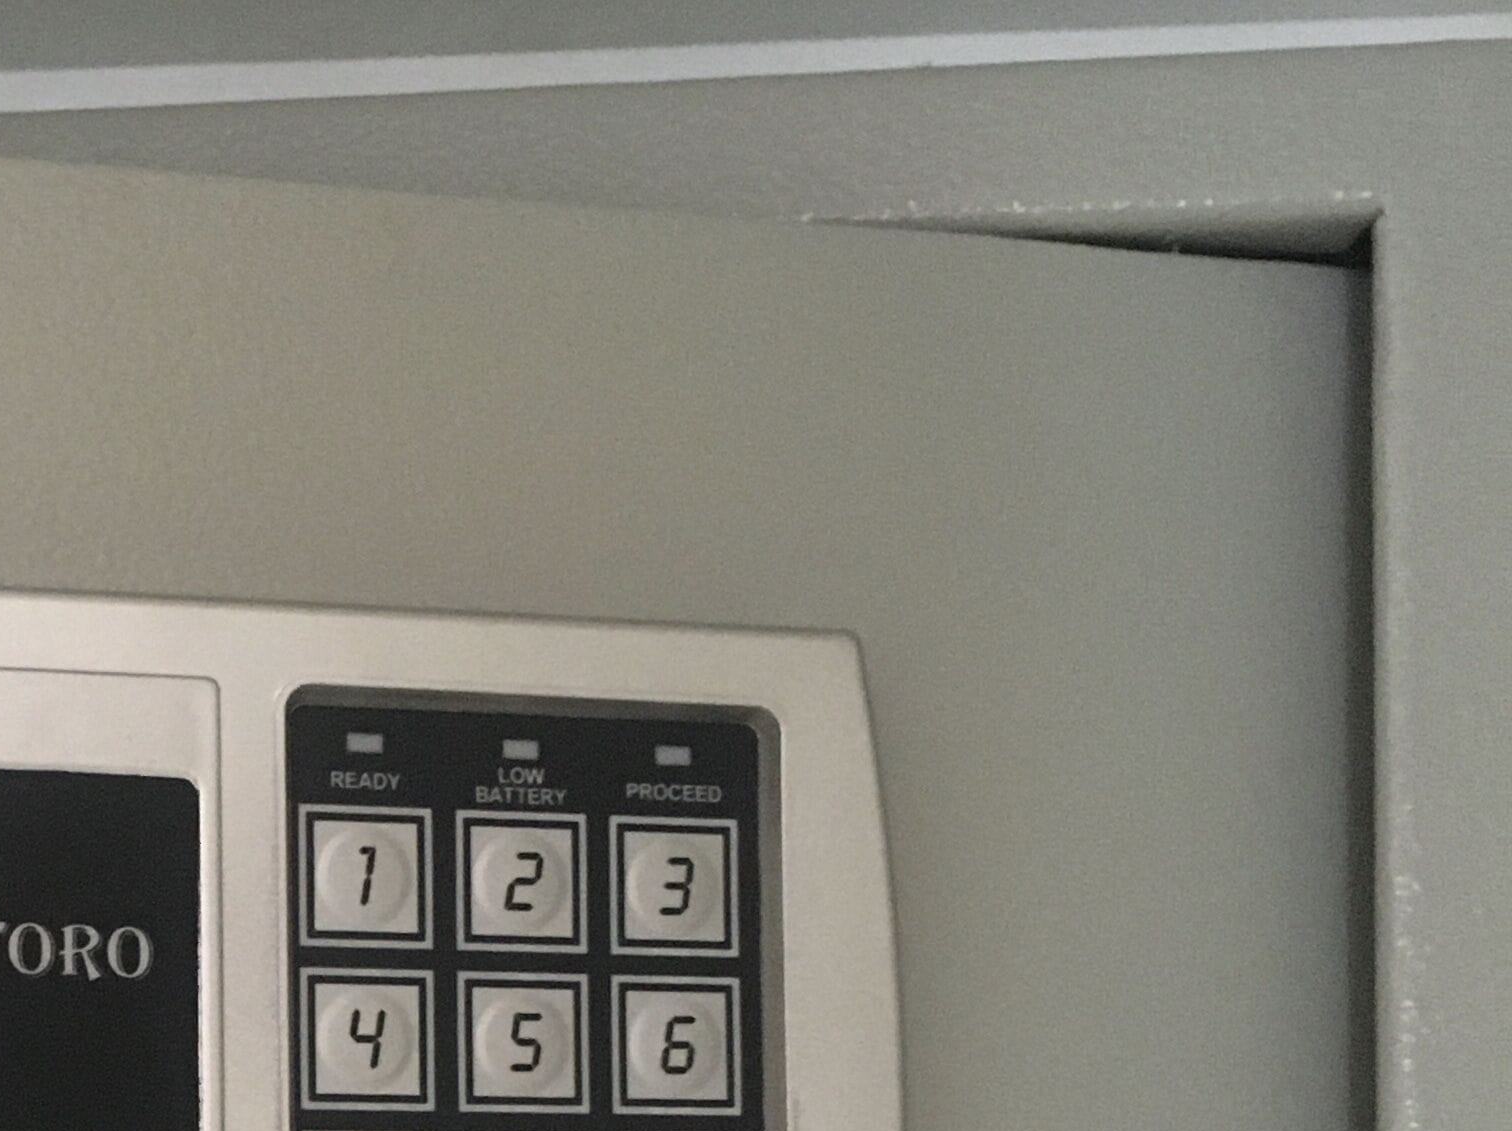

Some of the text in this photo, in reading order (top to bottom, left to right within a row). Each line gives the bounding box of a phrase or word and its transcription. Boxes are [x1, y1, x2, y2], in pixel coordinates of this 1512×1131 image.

[330, 770, 400, 791] READY
[475, 785, 567, 806] BATTERY
[497, 766, 545, 785] LOW
[625, 782, 723, 804] PROCEED
[358, 845, 377, 907] 1
[504, 851, 545, 912] 2
[659, 856, 695, 916] 3
[349, 1008, 387, 1070] 4
[510, 1012, 543, 1073] 5
[660, 1015, 697, 1075] 6
